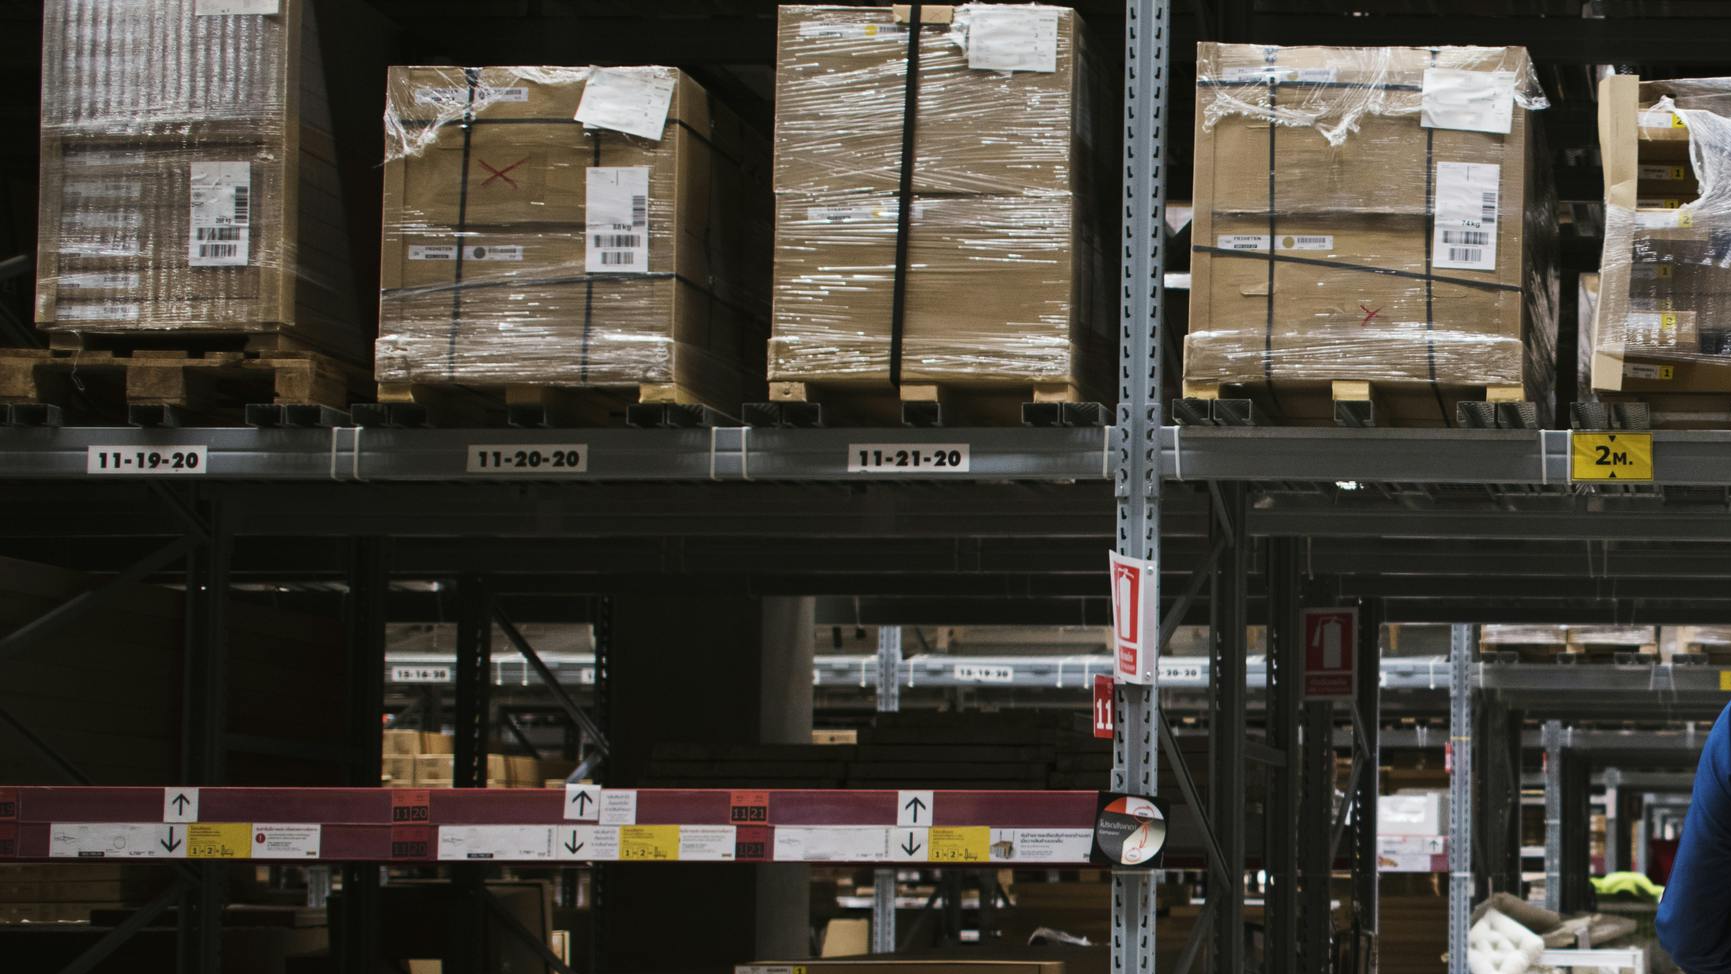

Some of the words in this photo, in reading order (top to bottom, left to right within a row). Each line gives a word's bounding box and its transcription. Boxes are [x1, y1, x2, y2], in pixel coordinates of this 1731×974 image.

[100, 452, 198, 468] 11-19-20
[479, 451, 579, 467] 11-20-20
[860, 450, 960, 466] 11-21-20
[395, 808, 409, 818] 11
[412, 808, 427, 818] 20
[733, 808, 748, 818] 11
[750, 808, 766, 818] 21
